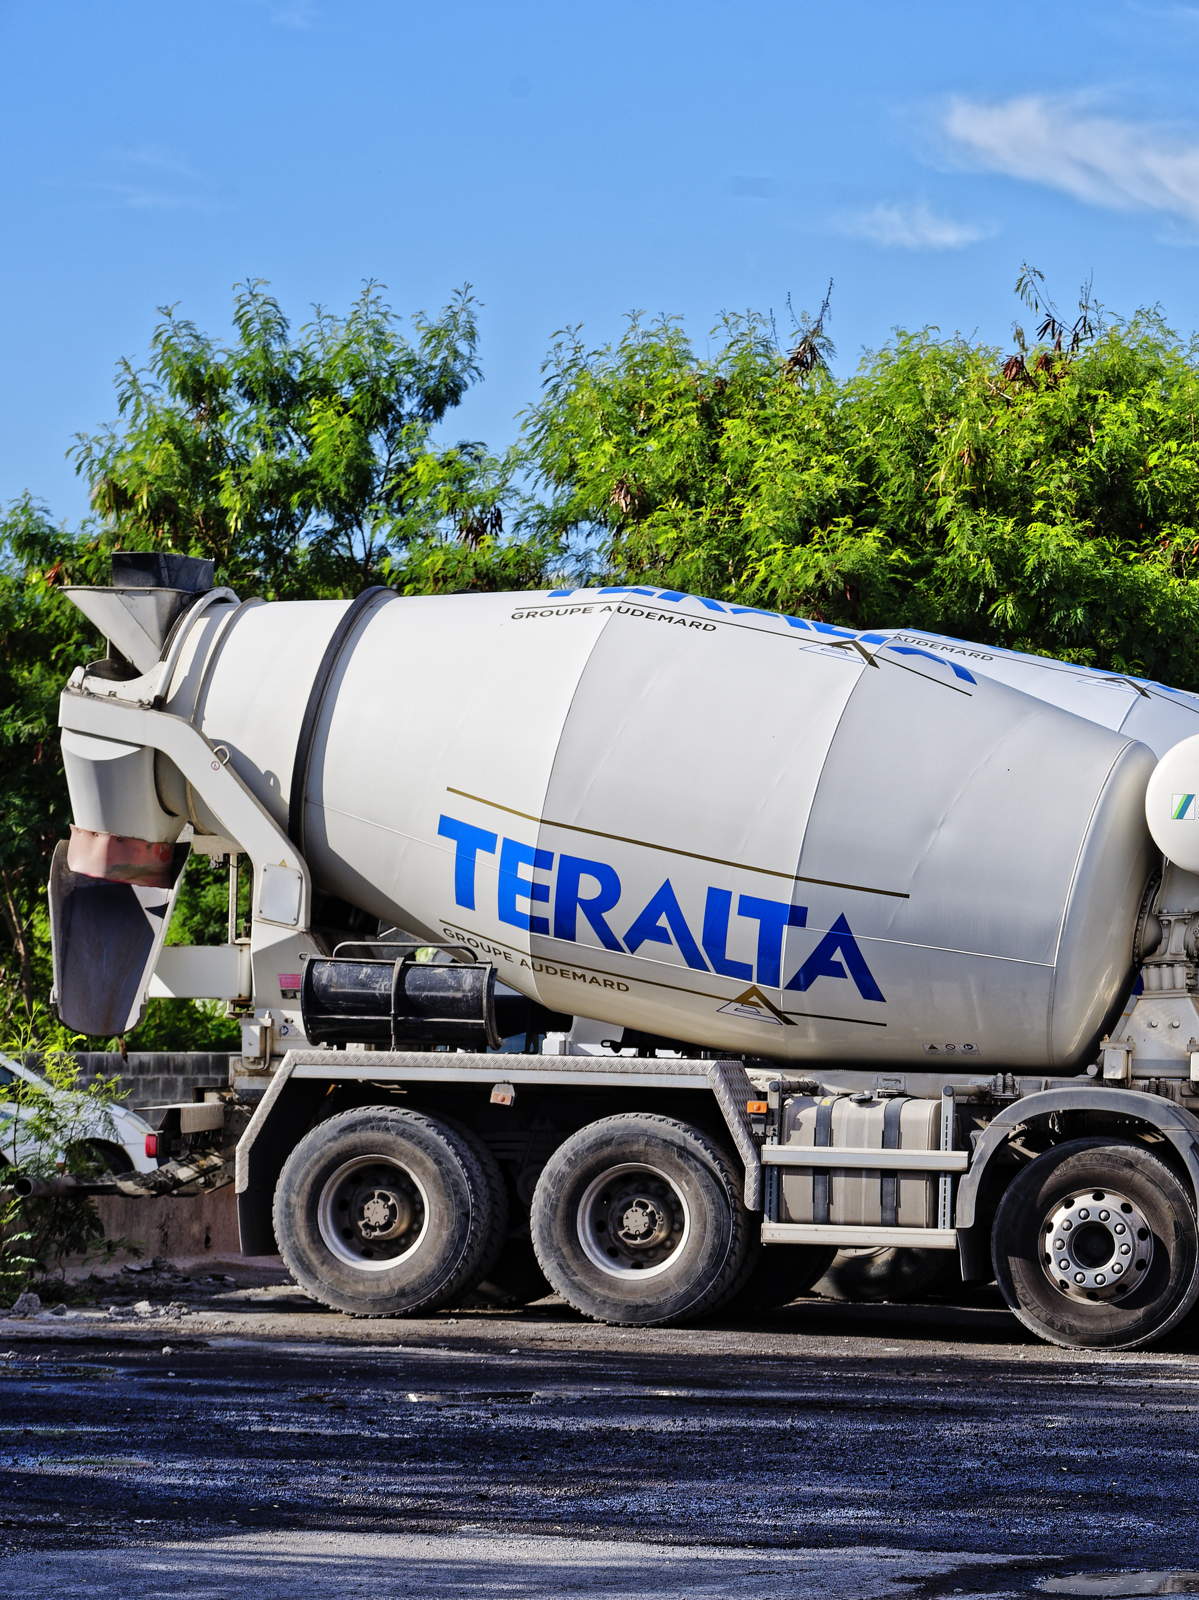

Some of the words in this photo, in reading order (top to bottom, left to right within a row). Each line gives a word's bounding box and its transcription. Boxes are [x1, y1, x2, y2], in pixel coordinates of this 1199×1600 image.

[511, 606, 594, 620] GROUPE
[600, 605, 717, 632] AUDEMARD
[893, 634, 994, 661] AUDEMARD
[437, 814, 887, 1003] TERALTA
[443, 928, 514, 963] GROUPE
[520, 957, 630, 993] AUDEMARD
